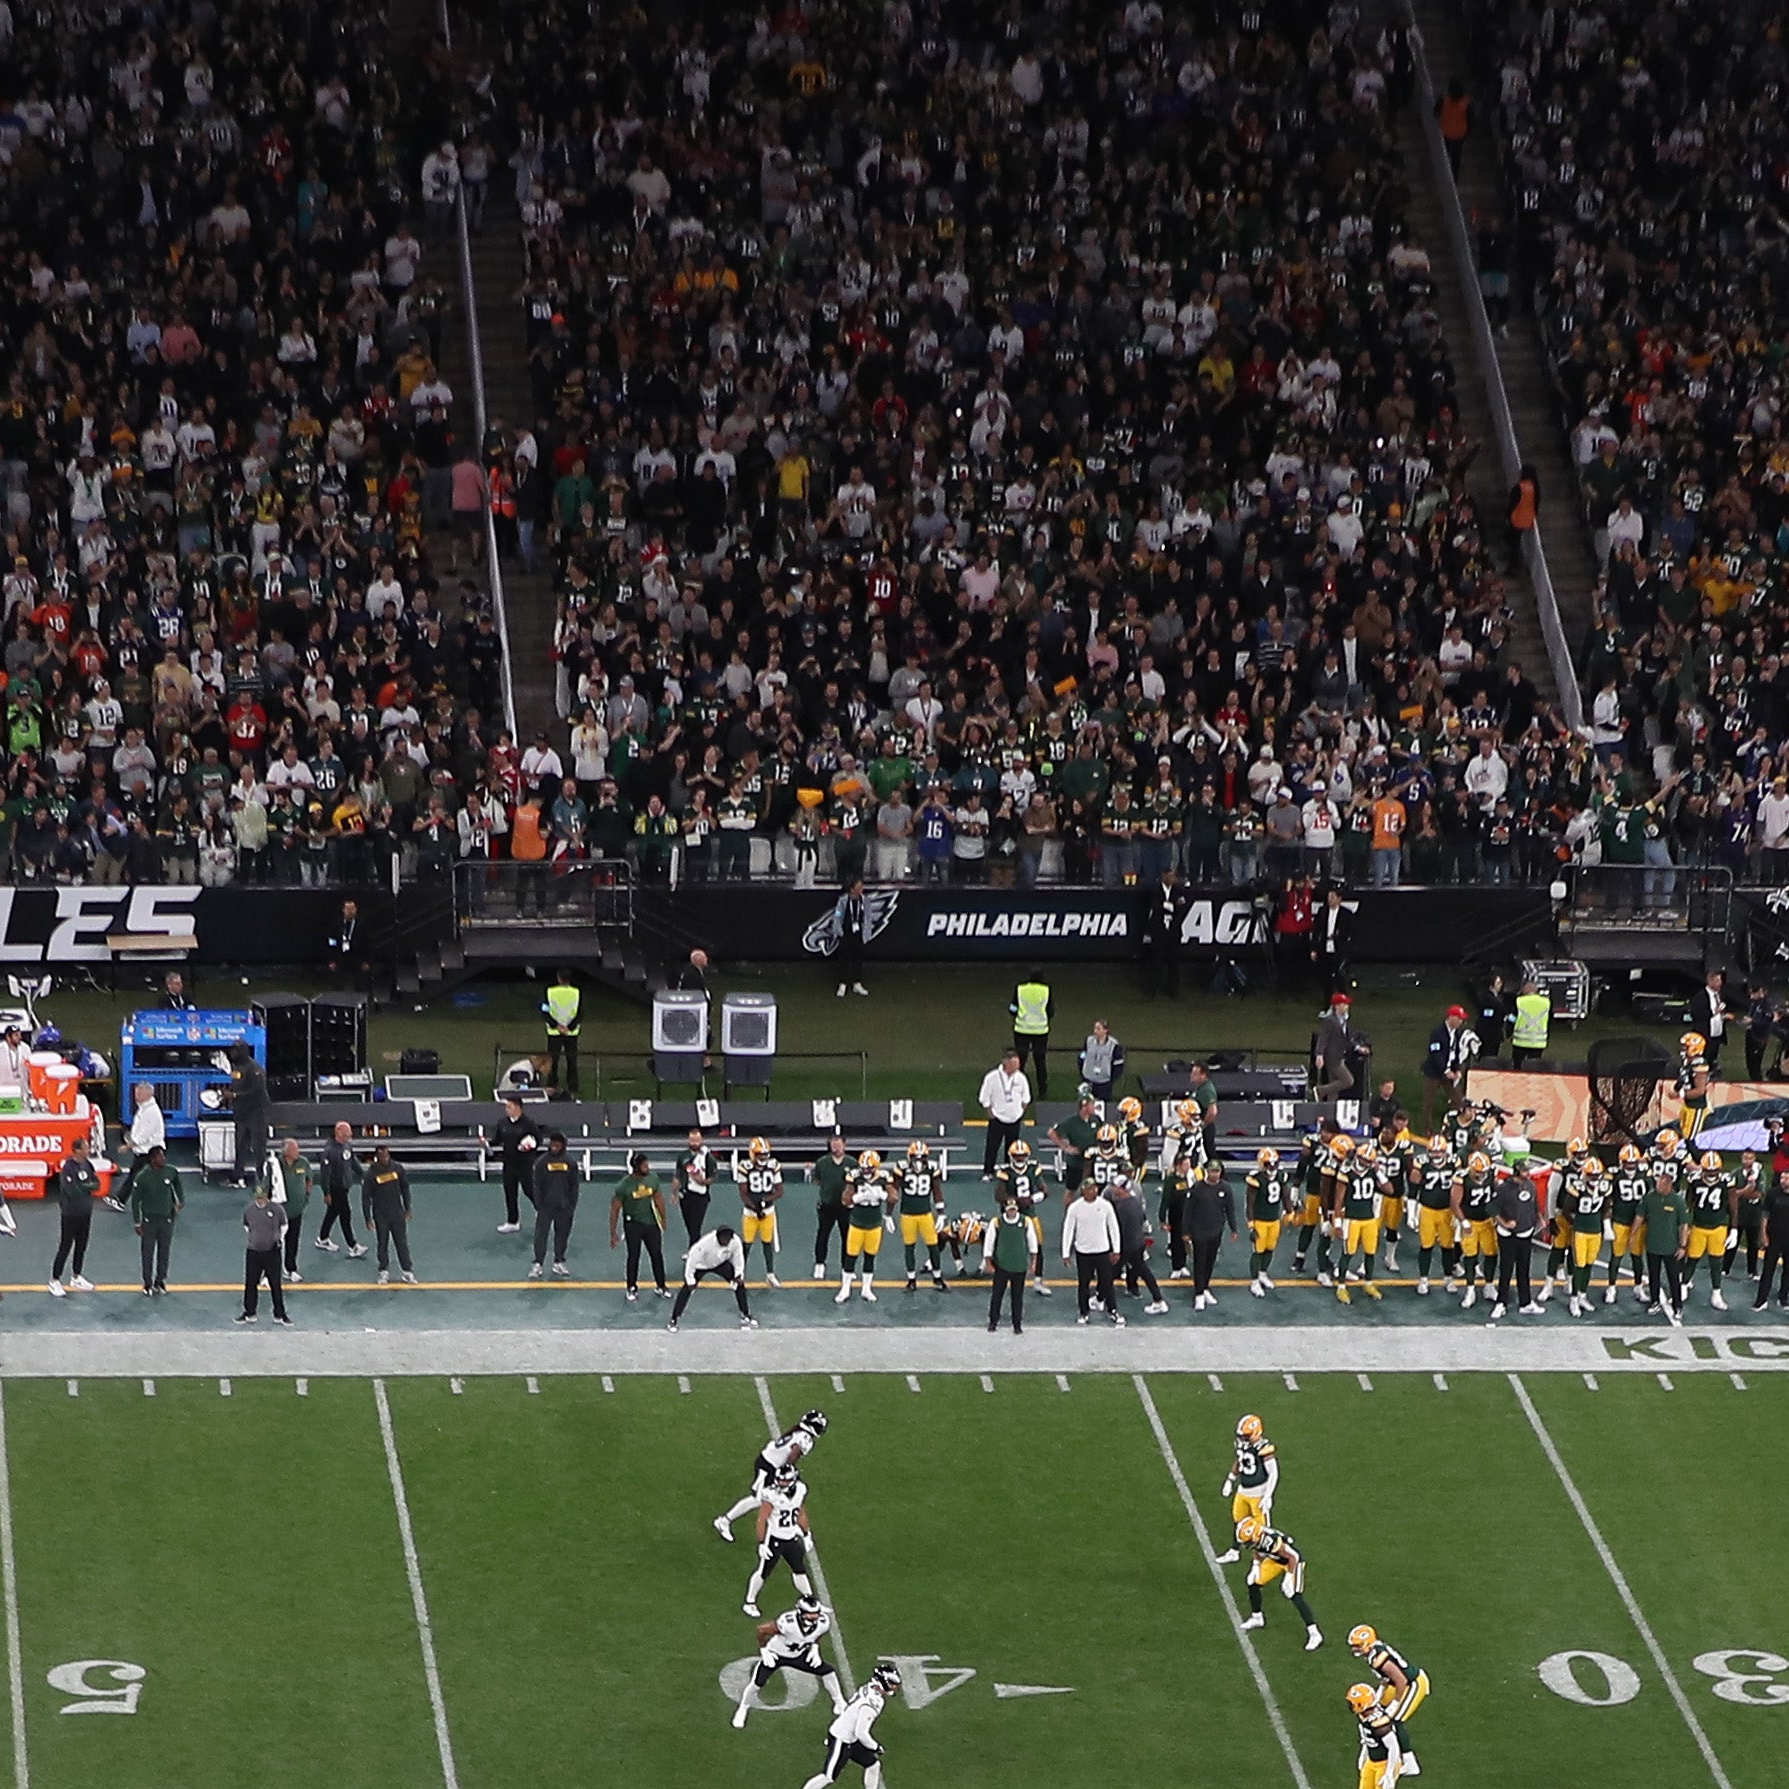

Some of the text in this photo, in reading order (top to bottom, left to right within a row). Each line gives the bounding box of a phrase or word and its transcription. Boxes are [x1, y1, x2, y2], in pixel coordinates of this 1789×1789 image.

[1683, 491, 1704, 512] 52
[874, 577, 891, 599] 10
[157, 617, 180, 639] 28
[98, 707, 117, 726] 12
[627, 738, 640, 758] 2
[1409, 737, 1421, 755] 4
[314, 769, 336, 791] 26
[926, 819, 944, 840] 16
[1614, 819, 1629, 843] 4
[1730, 821, 1751, 843] 74
[918, 913, 1128, 937] PHILADELPHIA
[748, 1172, 773, 1194] 80
[904, 1173, 932, 1195] 38
[1093, 1162, 1118, 1185] 56
[1426, 1170, 1454, 1191] 75
[1015, 1175, 1031, 1198] 2
[1352, 1178, 1375, 1201] 10
[1471, 1186, 1494, 1207] 71
[1618, 1178, 1647, 1202] 50
[1578, 1196, 1604, 1214] 87
[1695, 1186, 1723, 1211] 74
[779, 1510, 800, 1528] 26
